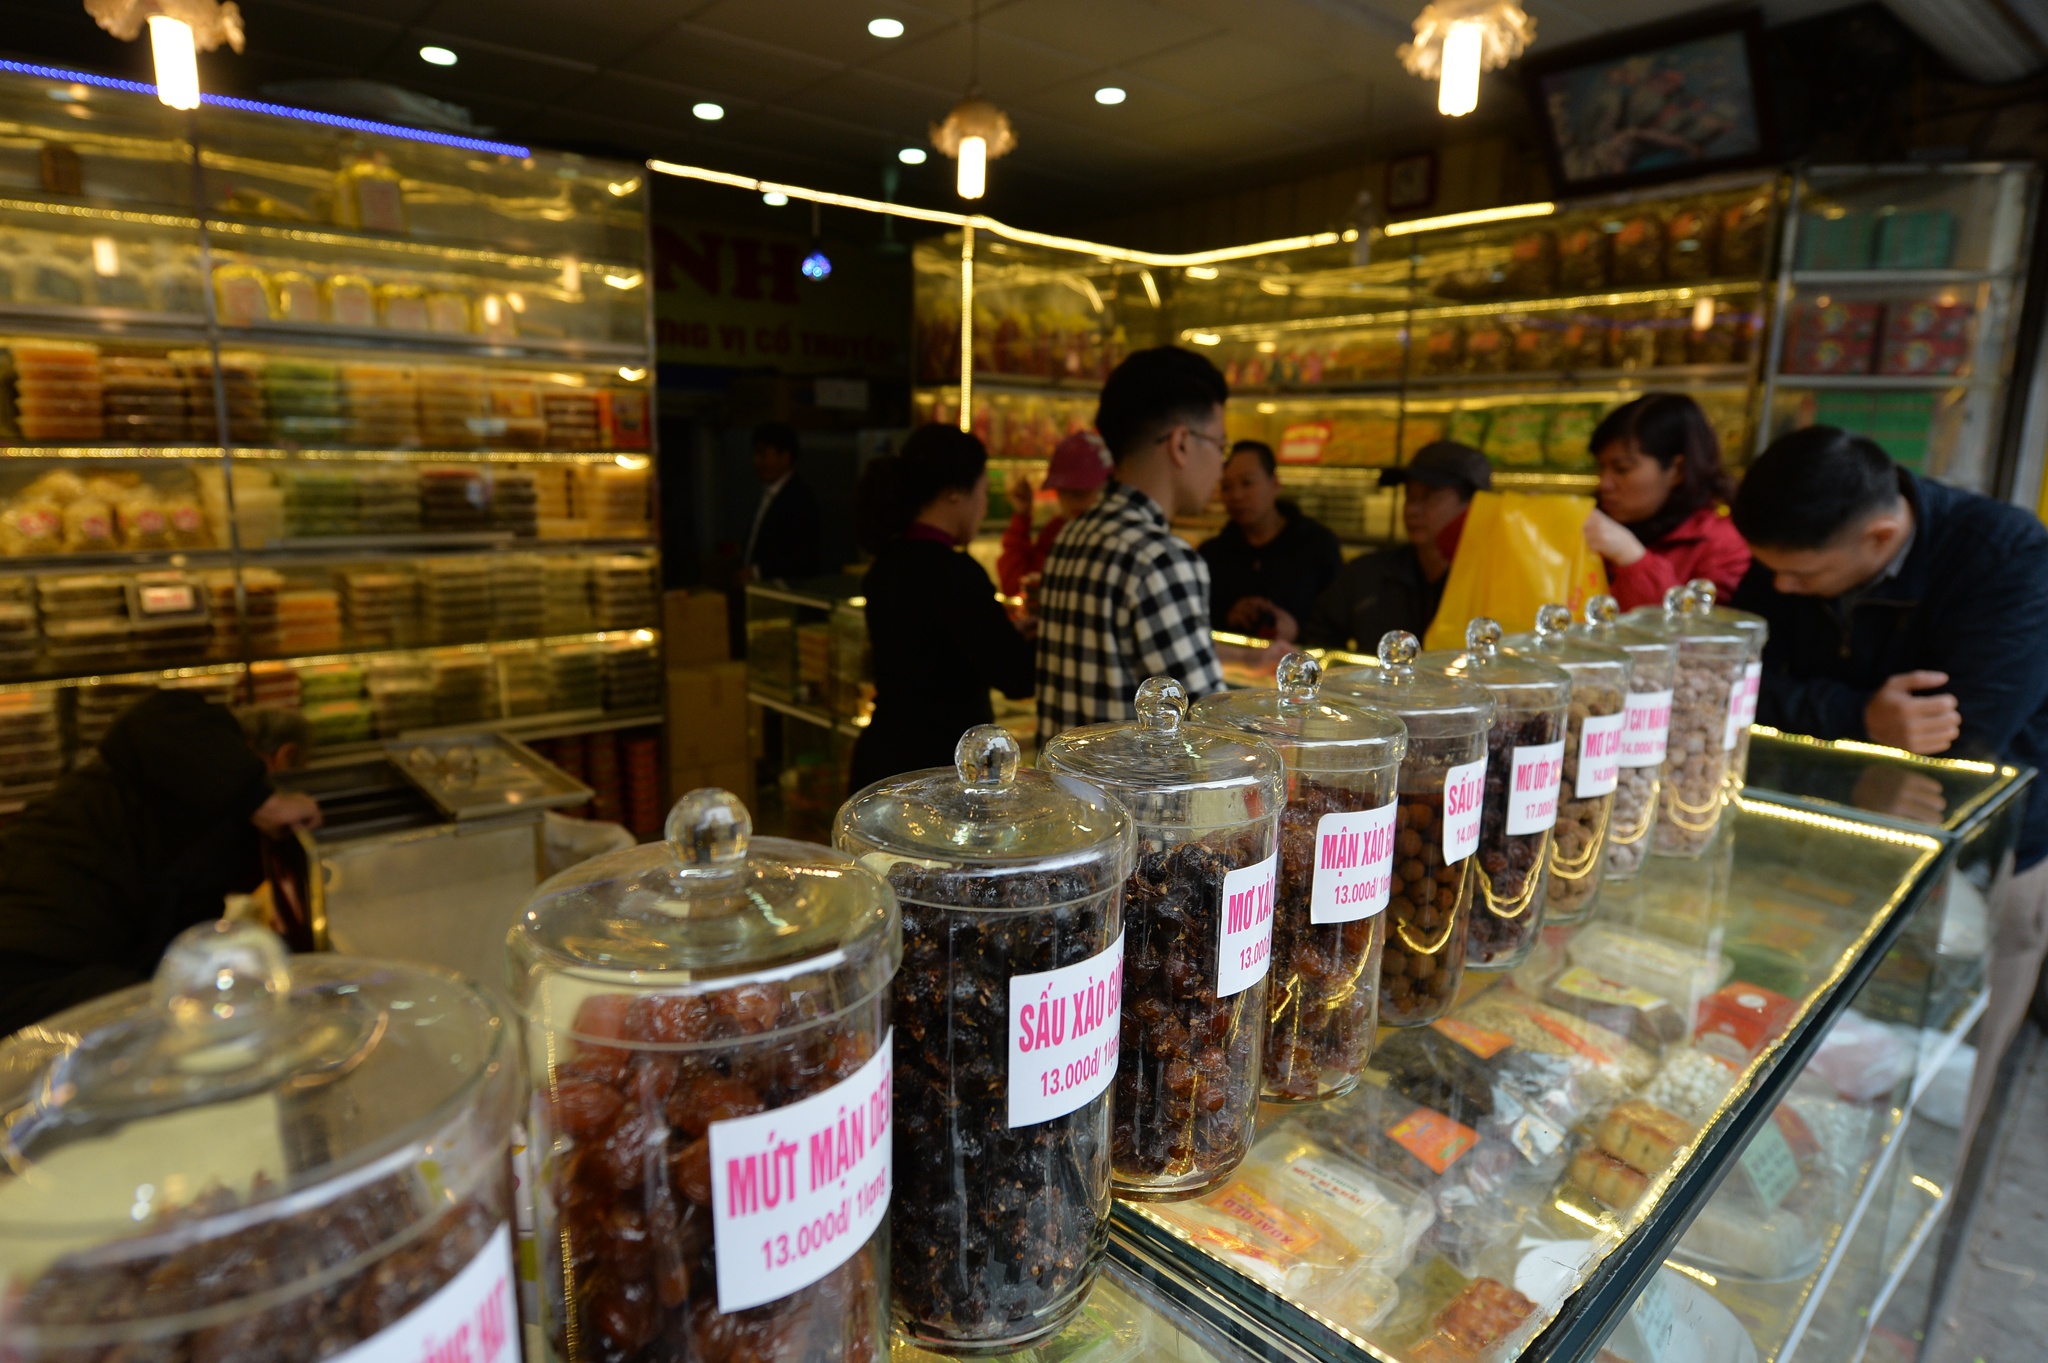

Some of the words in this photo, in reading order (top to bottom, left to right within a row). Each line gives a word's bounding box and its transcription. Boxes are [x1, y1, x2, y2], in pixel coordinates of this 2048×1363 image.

[1448, 772, 1475, 816] SẤU
[1320, 826, 1359, 878] MẬN
[1361, 822, 1385, 866] XÀO
[1227, 886, 1255, 935] MƠ
[1019, 982, 1066, 1053] SẤU
[1071, 976, 1105, 1040] XÀO
[726, 1129, 798, 1219] MỨT
[810, 1106, 865, 1194] MẬN
